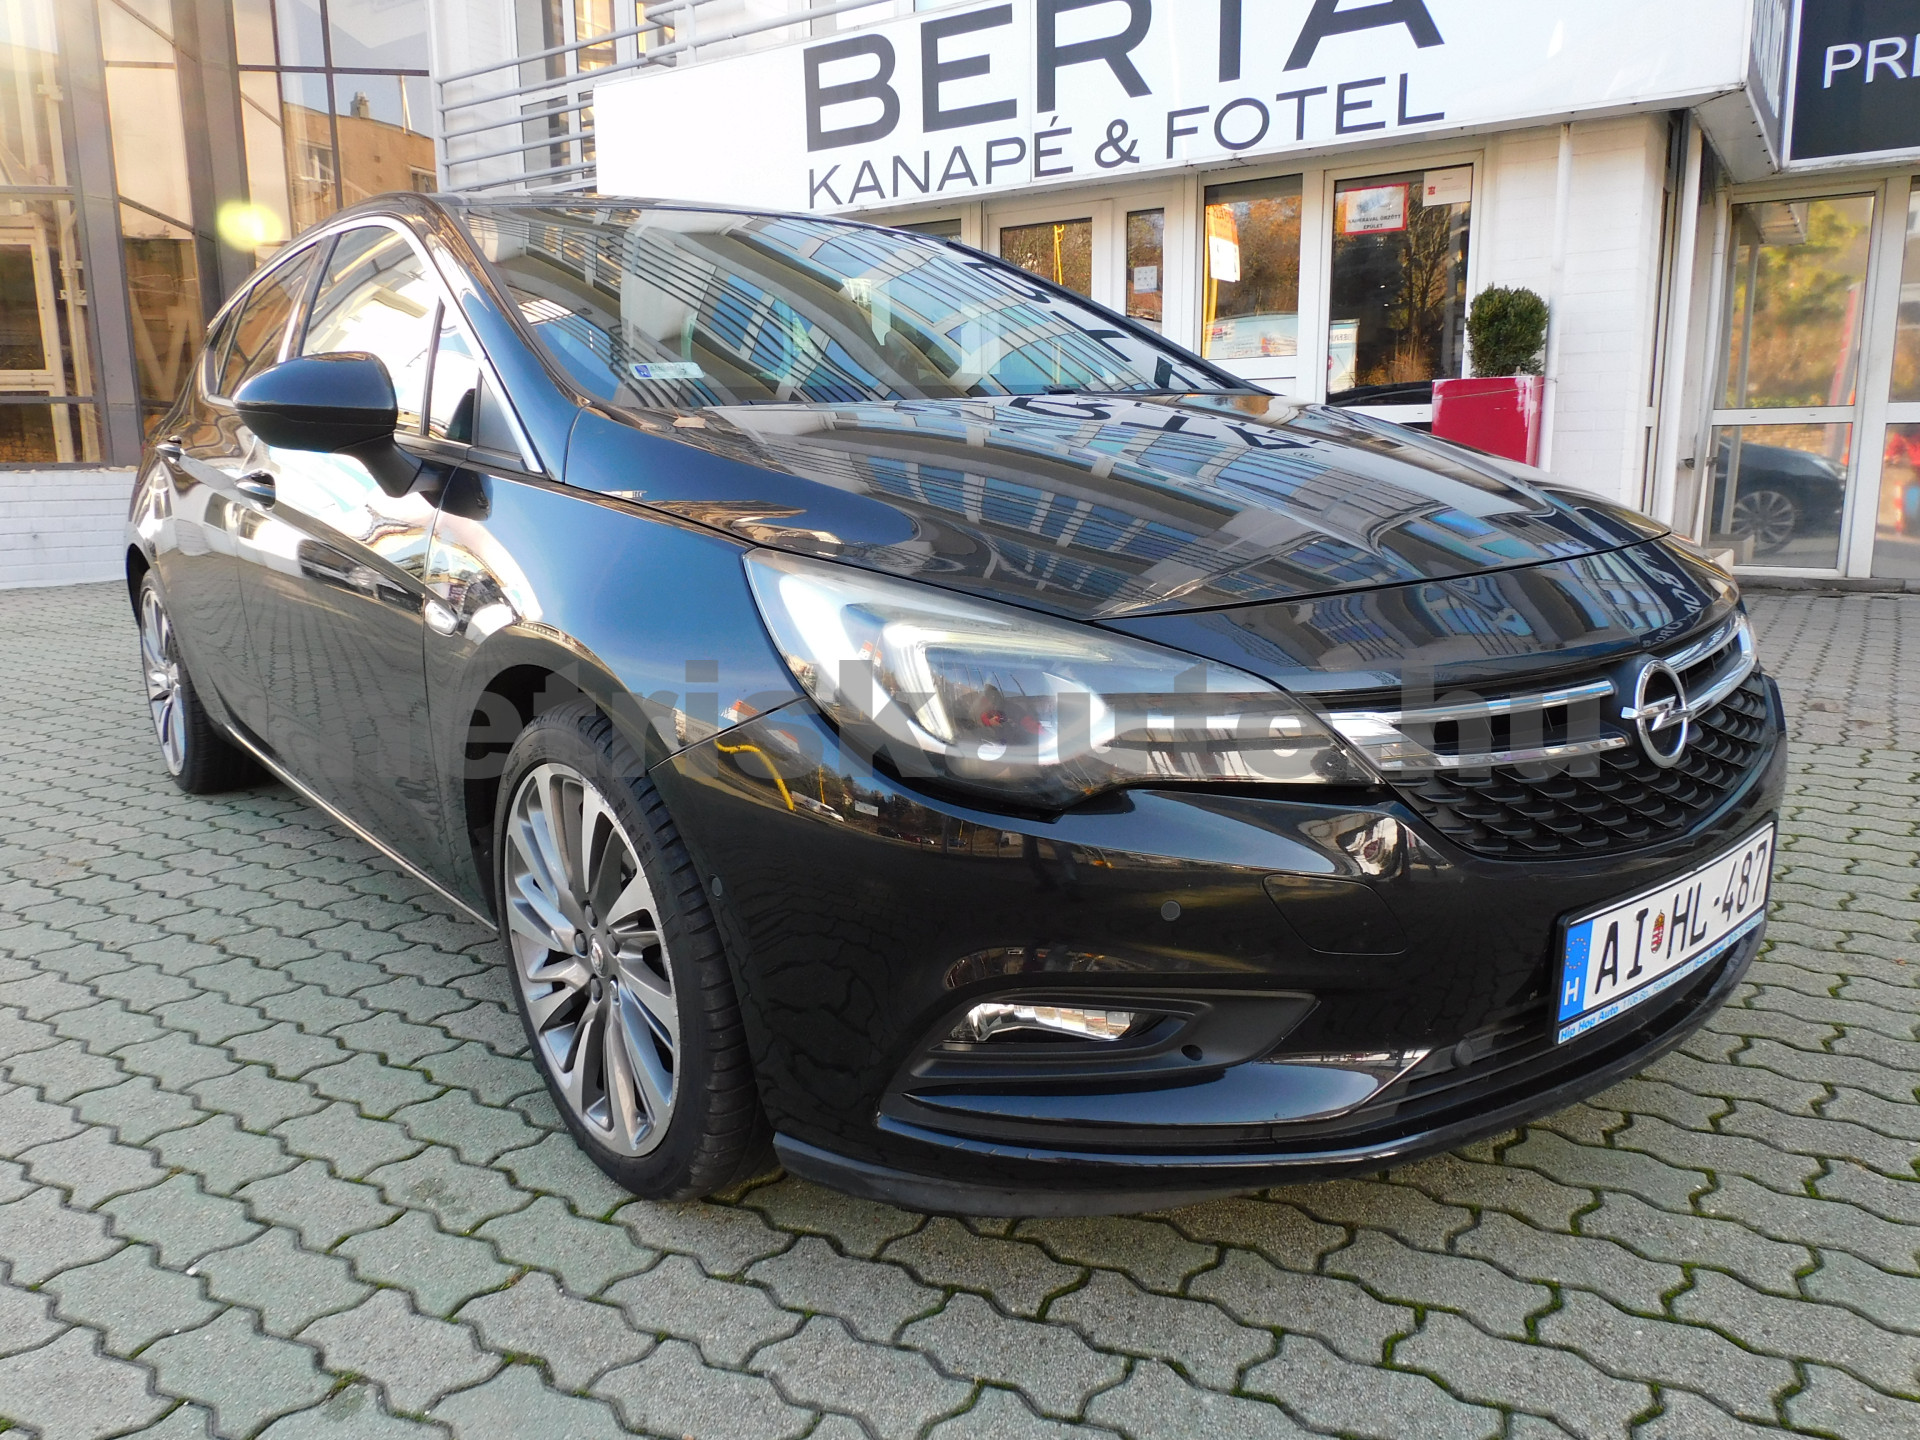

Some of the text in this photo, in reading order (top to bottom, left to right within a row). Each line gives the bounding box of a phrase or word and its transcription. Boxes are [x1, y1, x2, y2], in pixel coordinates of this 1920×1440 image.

[808, 74, 1445, 209] KANAPÉ & FOTEL
[1595, 908, 1649, 994] AI
[1564, 977, 1579, 1006] H
[1561, 1026, 1576, 1041] Hip
[1579, 1017, 1596, 1033] Hop
[1598, 1004, 1618, 1022] Auto
